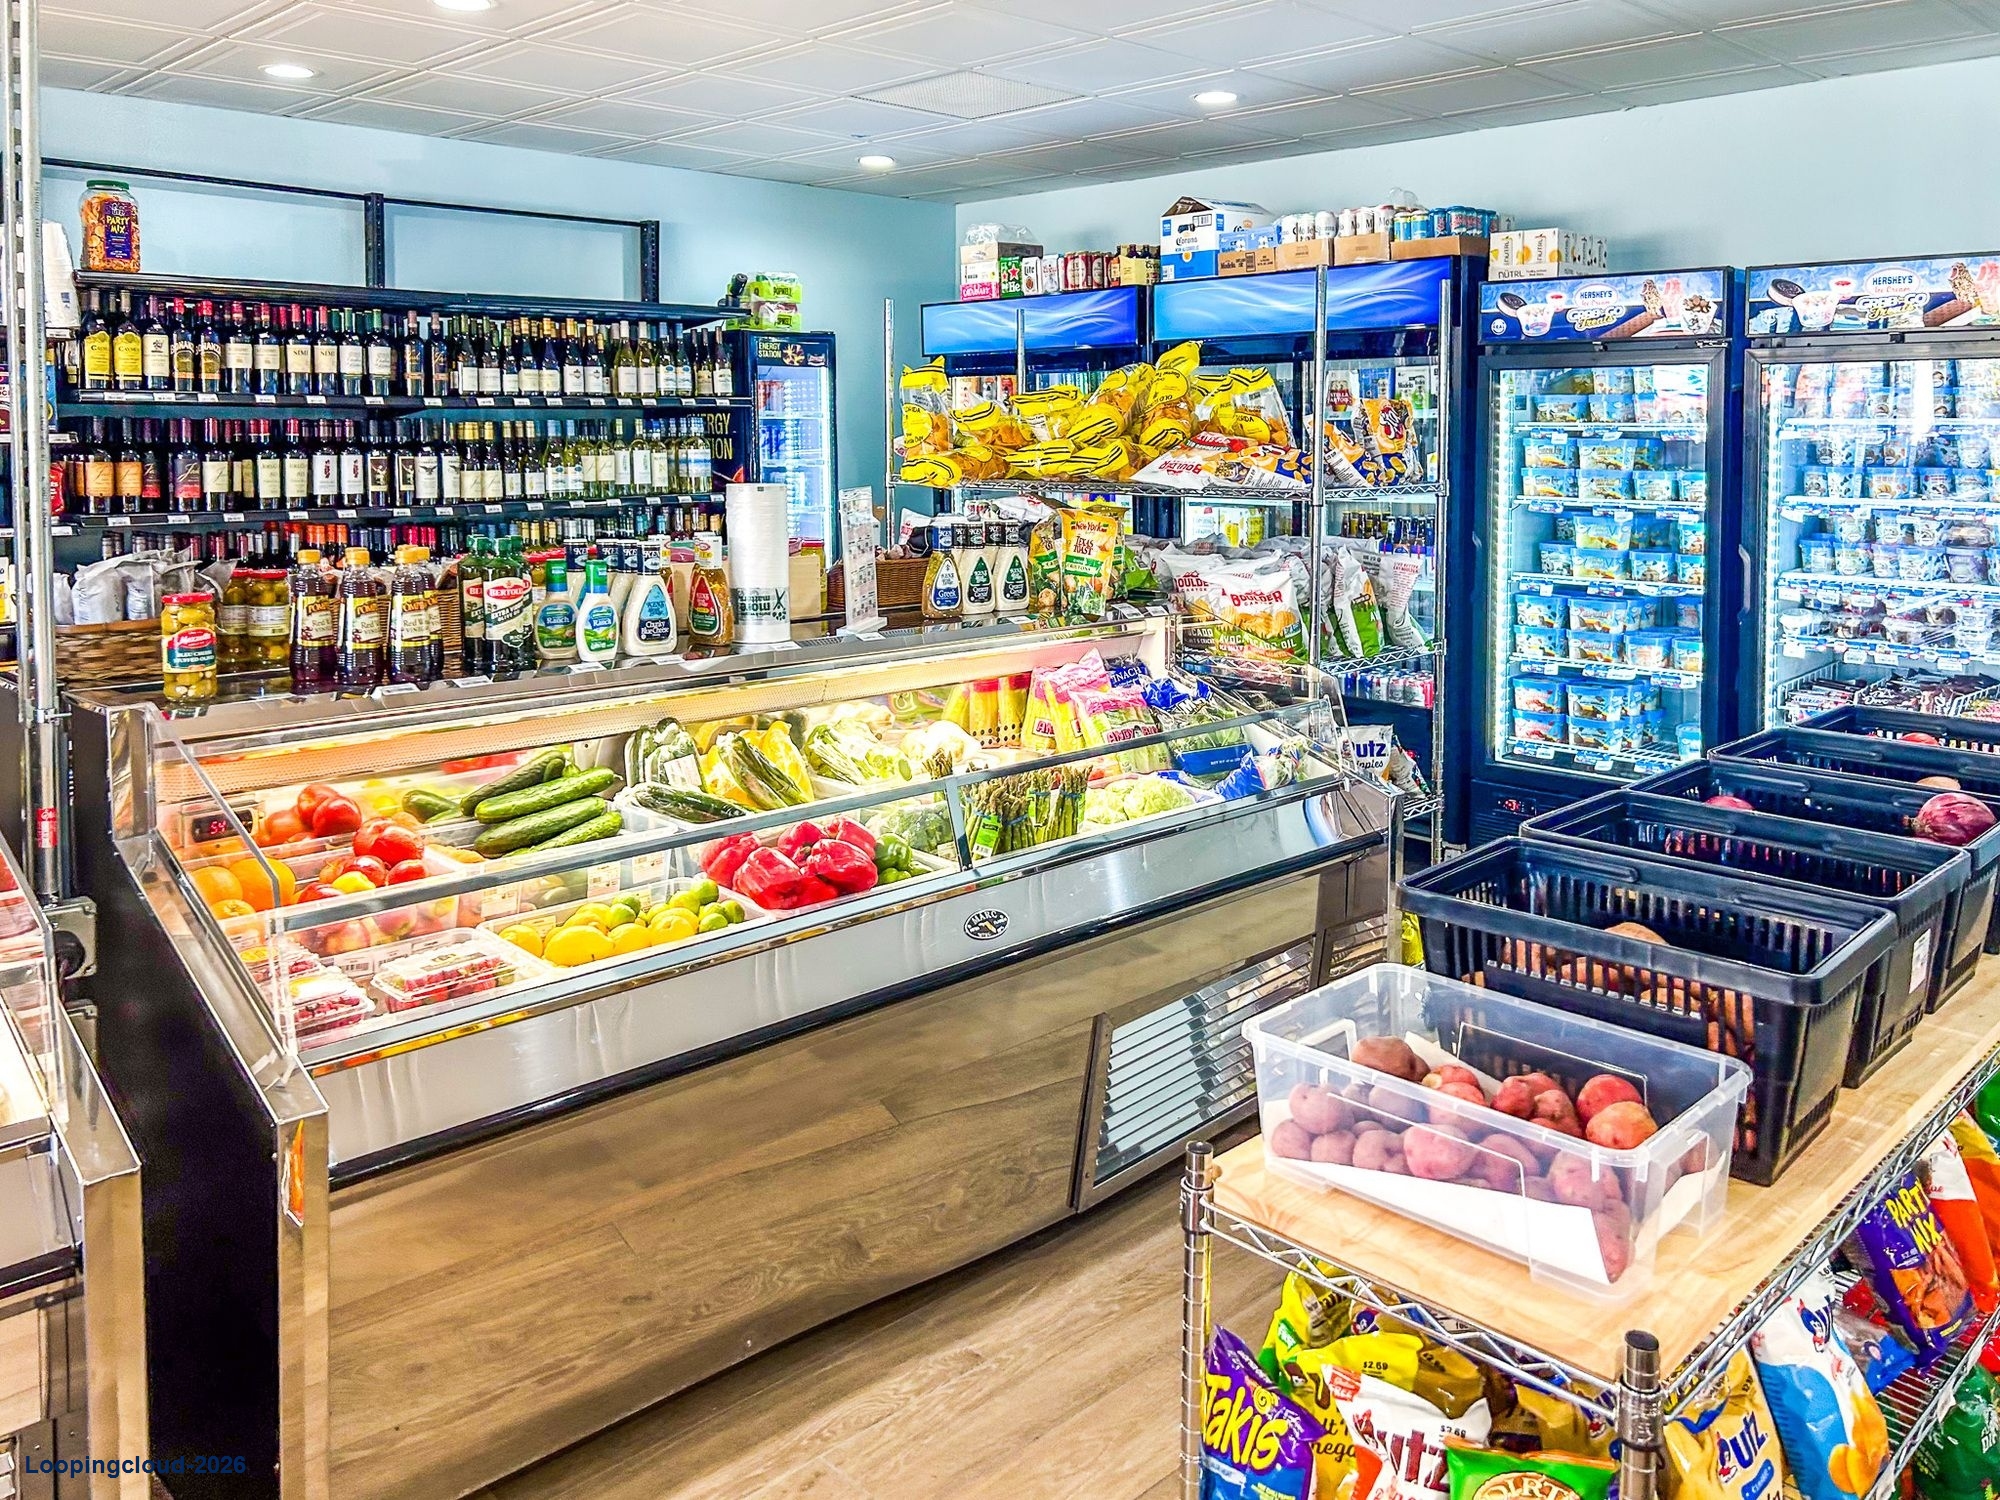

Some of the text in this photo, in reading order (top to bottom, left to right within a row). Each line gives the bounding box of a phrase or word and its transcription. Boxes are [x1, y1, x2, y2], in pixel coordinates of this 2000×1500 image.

[106, 215, 130, 225] PARTY
[111, 223, 126, 234] MIX
[1175, 236, 1198, 246] Corona
[1024, 264, 1035, 276] Lite
[1872, 275, 1913, 286] HERSHEY'S
[1580, 289, 1613, 299] HERSHEY'S
[1579, 313, 1617, 329] Treats
[758, 342, 781, 351] ENERGY
[758, 349, 782, 359] STATION
[1075, 520, 1102, 532] New York
[1075, 536, 1093, 547] TEXAS
[1073, 544, 1093, 556] TOAST
[938, 589, 957, 598] Greek
[1230, 589, 1283, 607] BOULDER
[312, 619, 326, 627] Red
[361, 620, 373, 629] Red
[403, 618, 417, 627] Red
[546, 615, 570, 625] Ranch
[593, 618, 612, 628] Ranch
[1281, 638, 1297, 649] OIL
[1107, 729, 1136, 743] ANDY
[1355, 740, 1387, 758] utz
[209, 820, 228, 834] 54
[971, 910, 998, 925] MARC
[1885, 1176, 1931, 1229] PARTY
[1910, 1212, 1942, 1254] MIX
